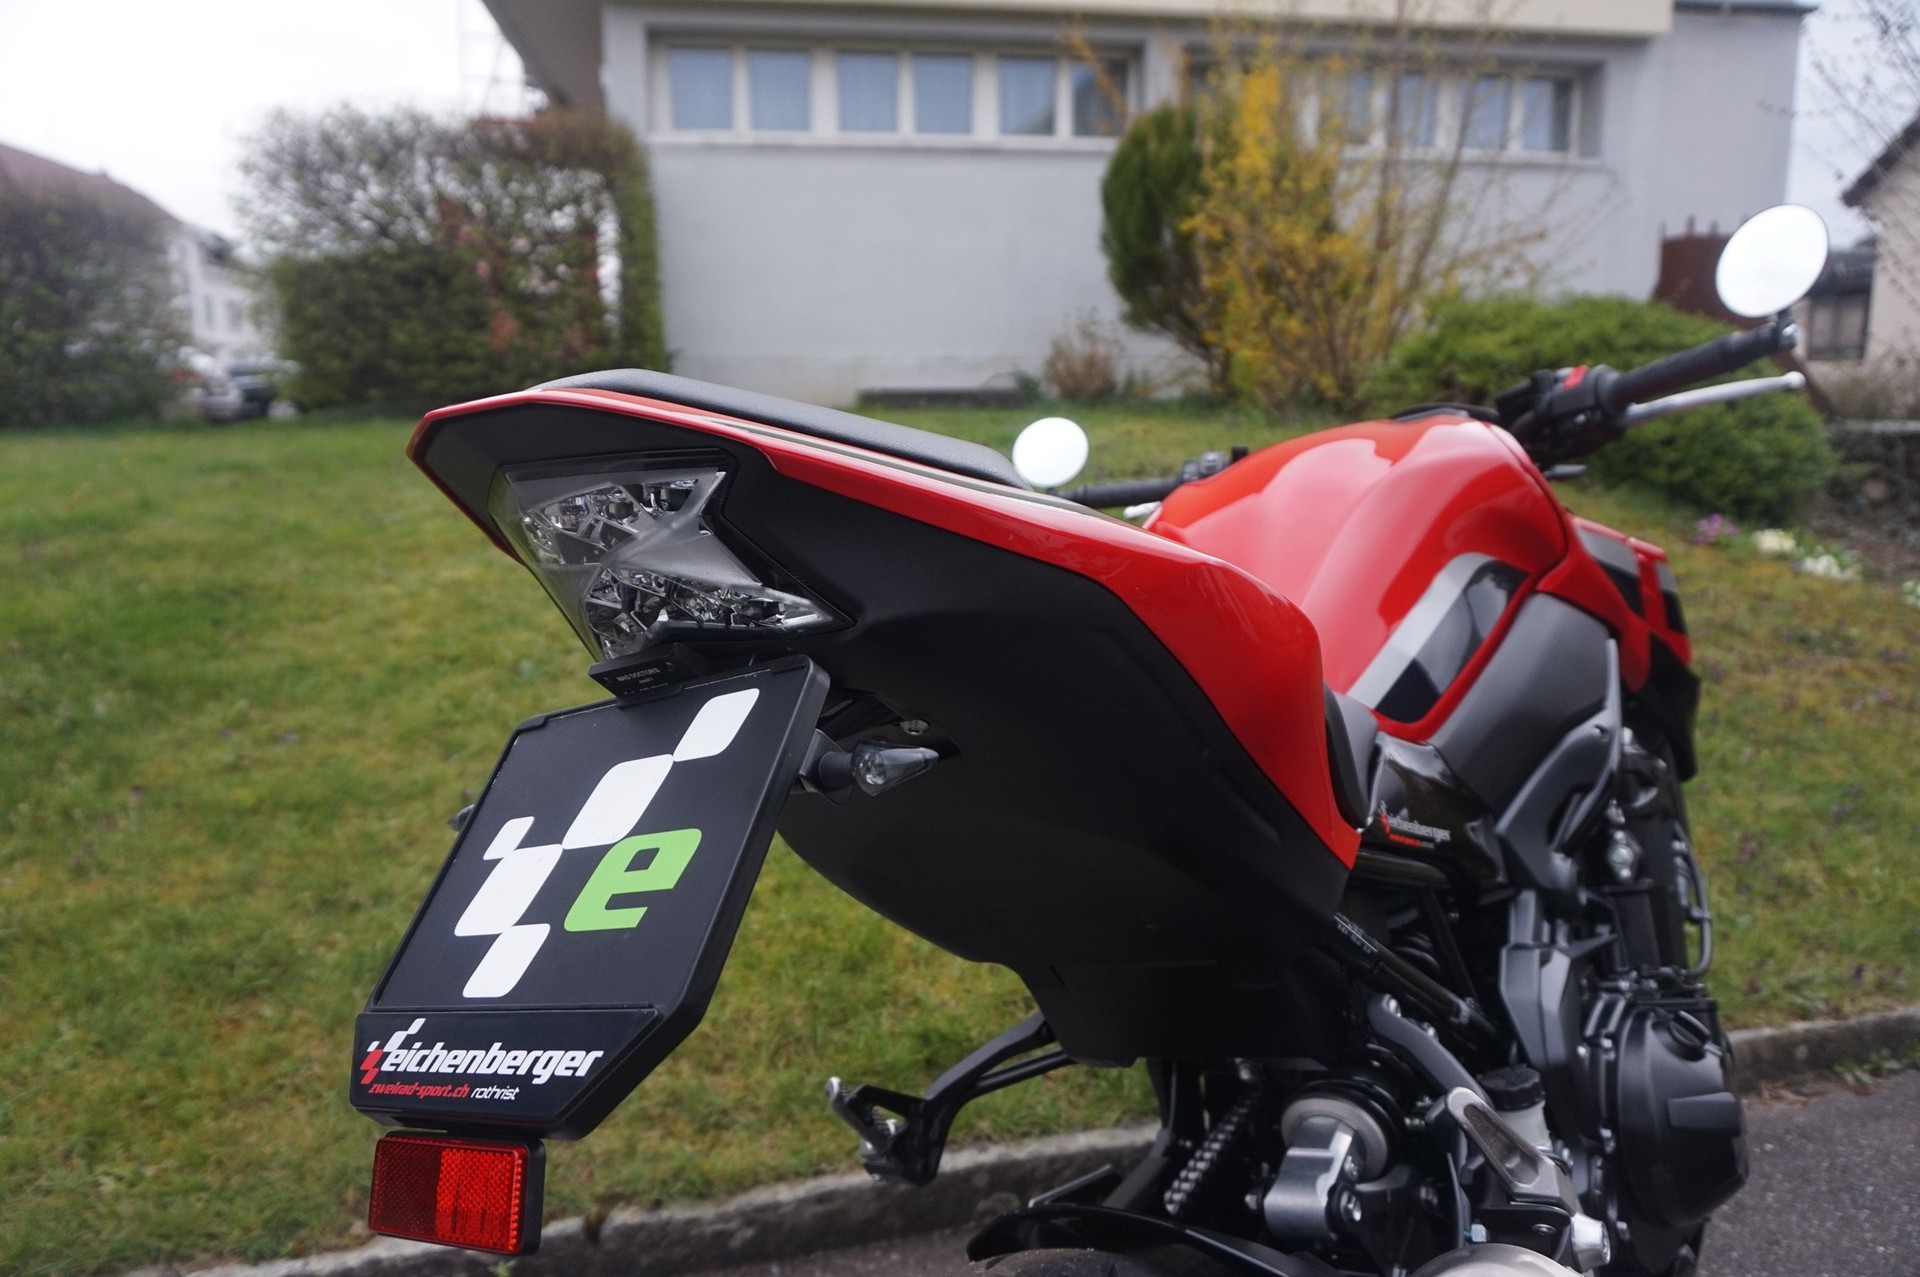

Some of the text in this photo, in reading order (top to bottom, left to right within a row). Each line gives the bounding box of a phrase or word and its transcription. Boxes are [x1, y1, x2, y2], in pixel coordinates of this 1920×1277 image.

[564, 828, 702, 932] e
[381, 1041, 604, 1085] eichenberger
[368, 1081, 520, 1100] zweirad-sport.ch rothrist
